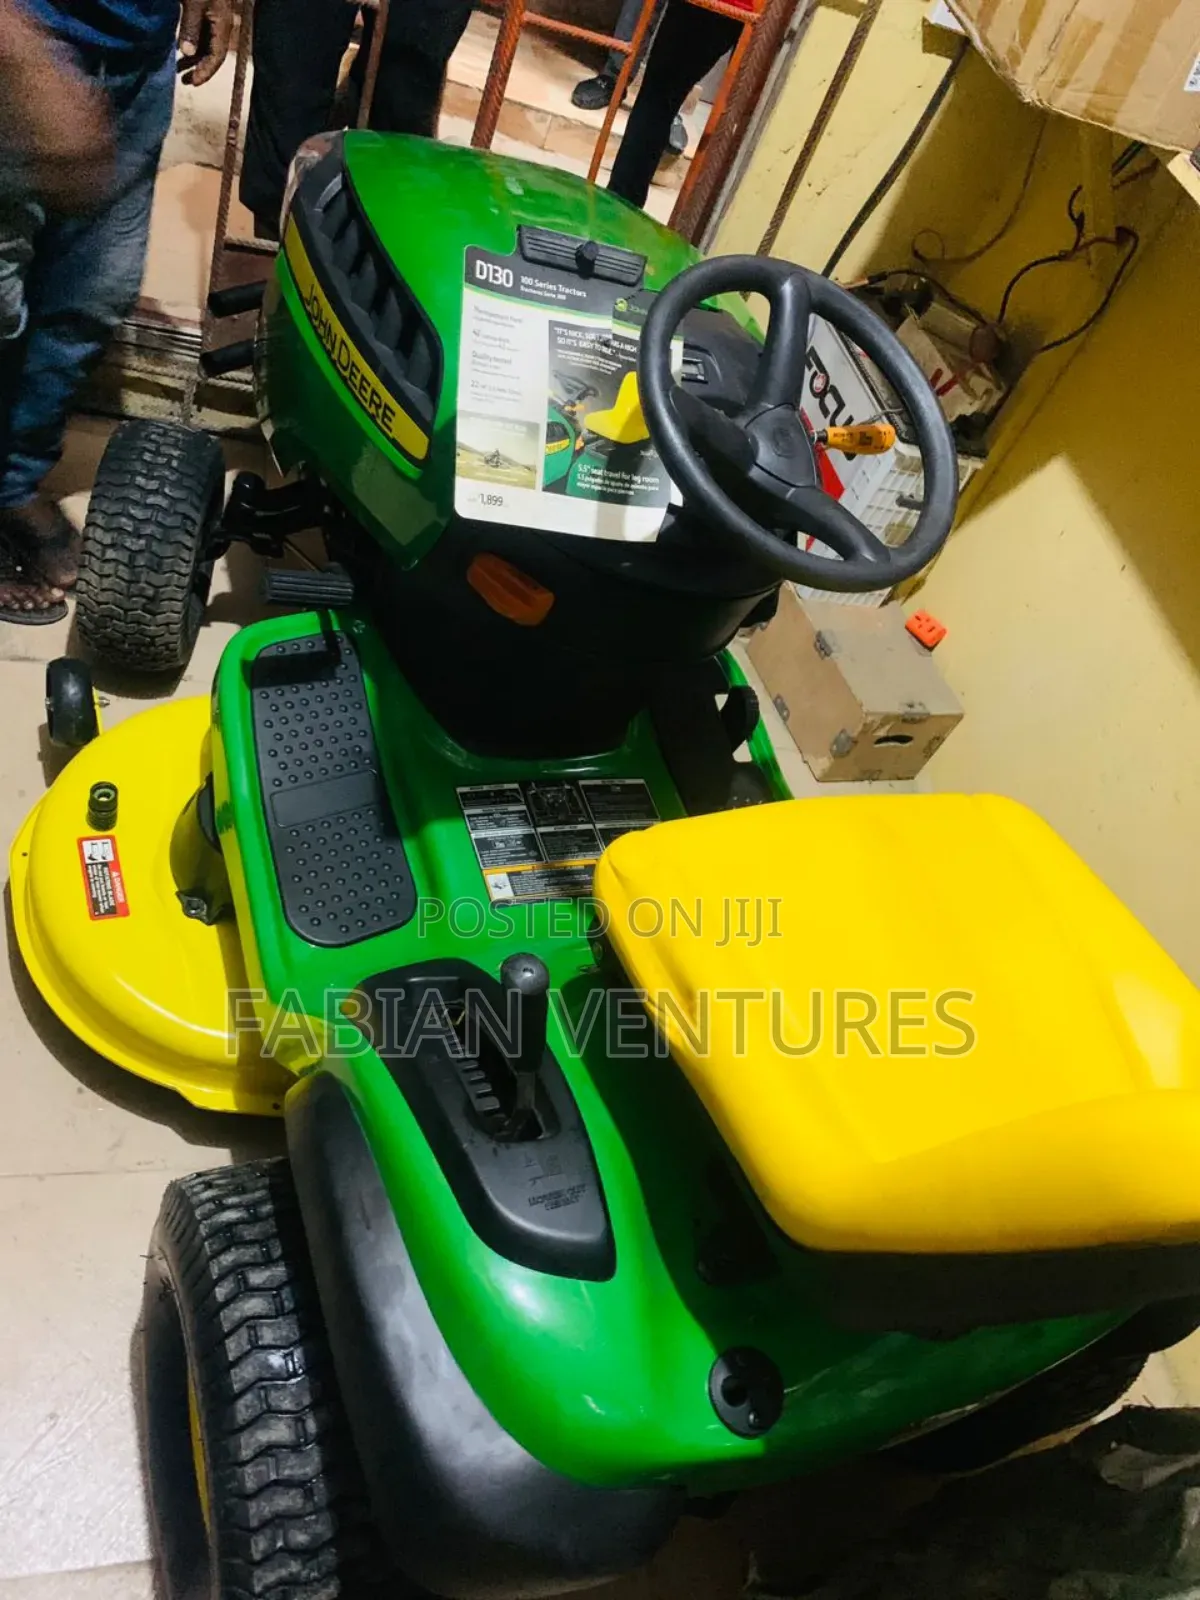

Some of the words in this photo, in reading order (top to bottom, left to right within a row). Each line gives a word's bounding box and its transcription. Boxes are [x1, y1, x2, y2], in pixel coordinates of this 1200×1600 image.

[475, 259, 513, 288] D130
[520, 275, 533, 286] 100
[534, 278, 557, 291] Series
[558, 284, 587, 298] Tractors
[303, 283, 338, 357] JOHN
[336, 340, 396, 434] DEERE
[604, 469, 621, 479] travel
[479, 492, 504, 508] 1,899
